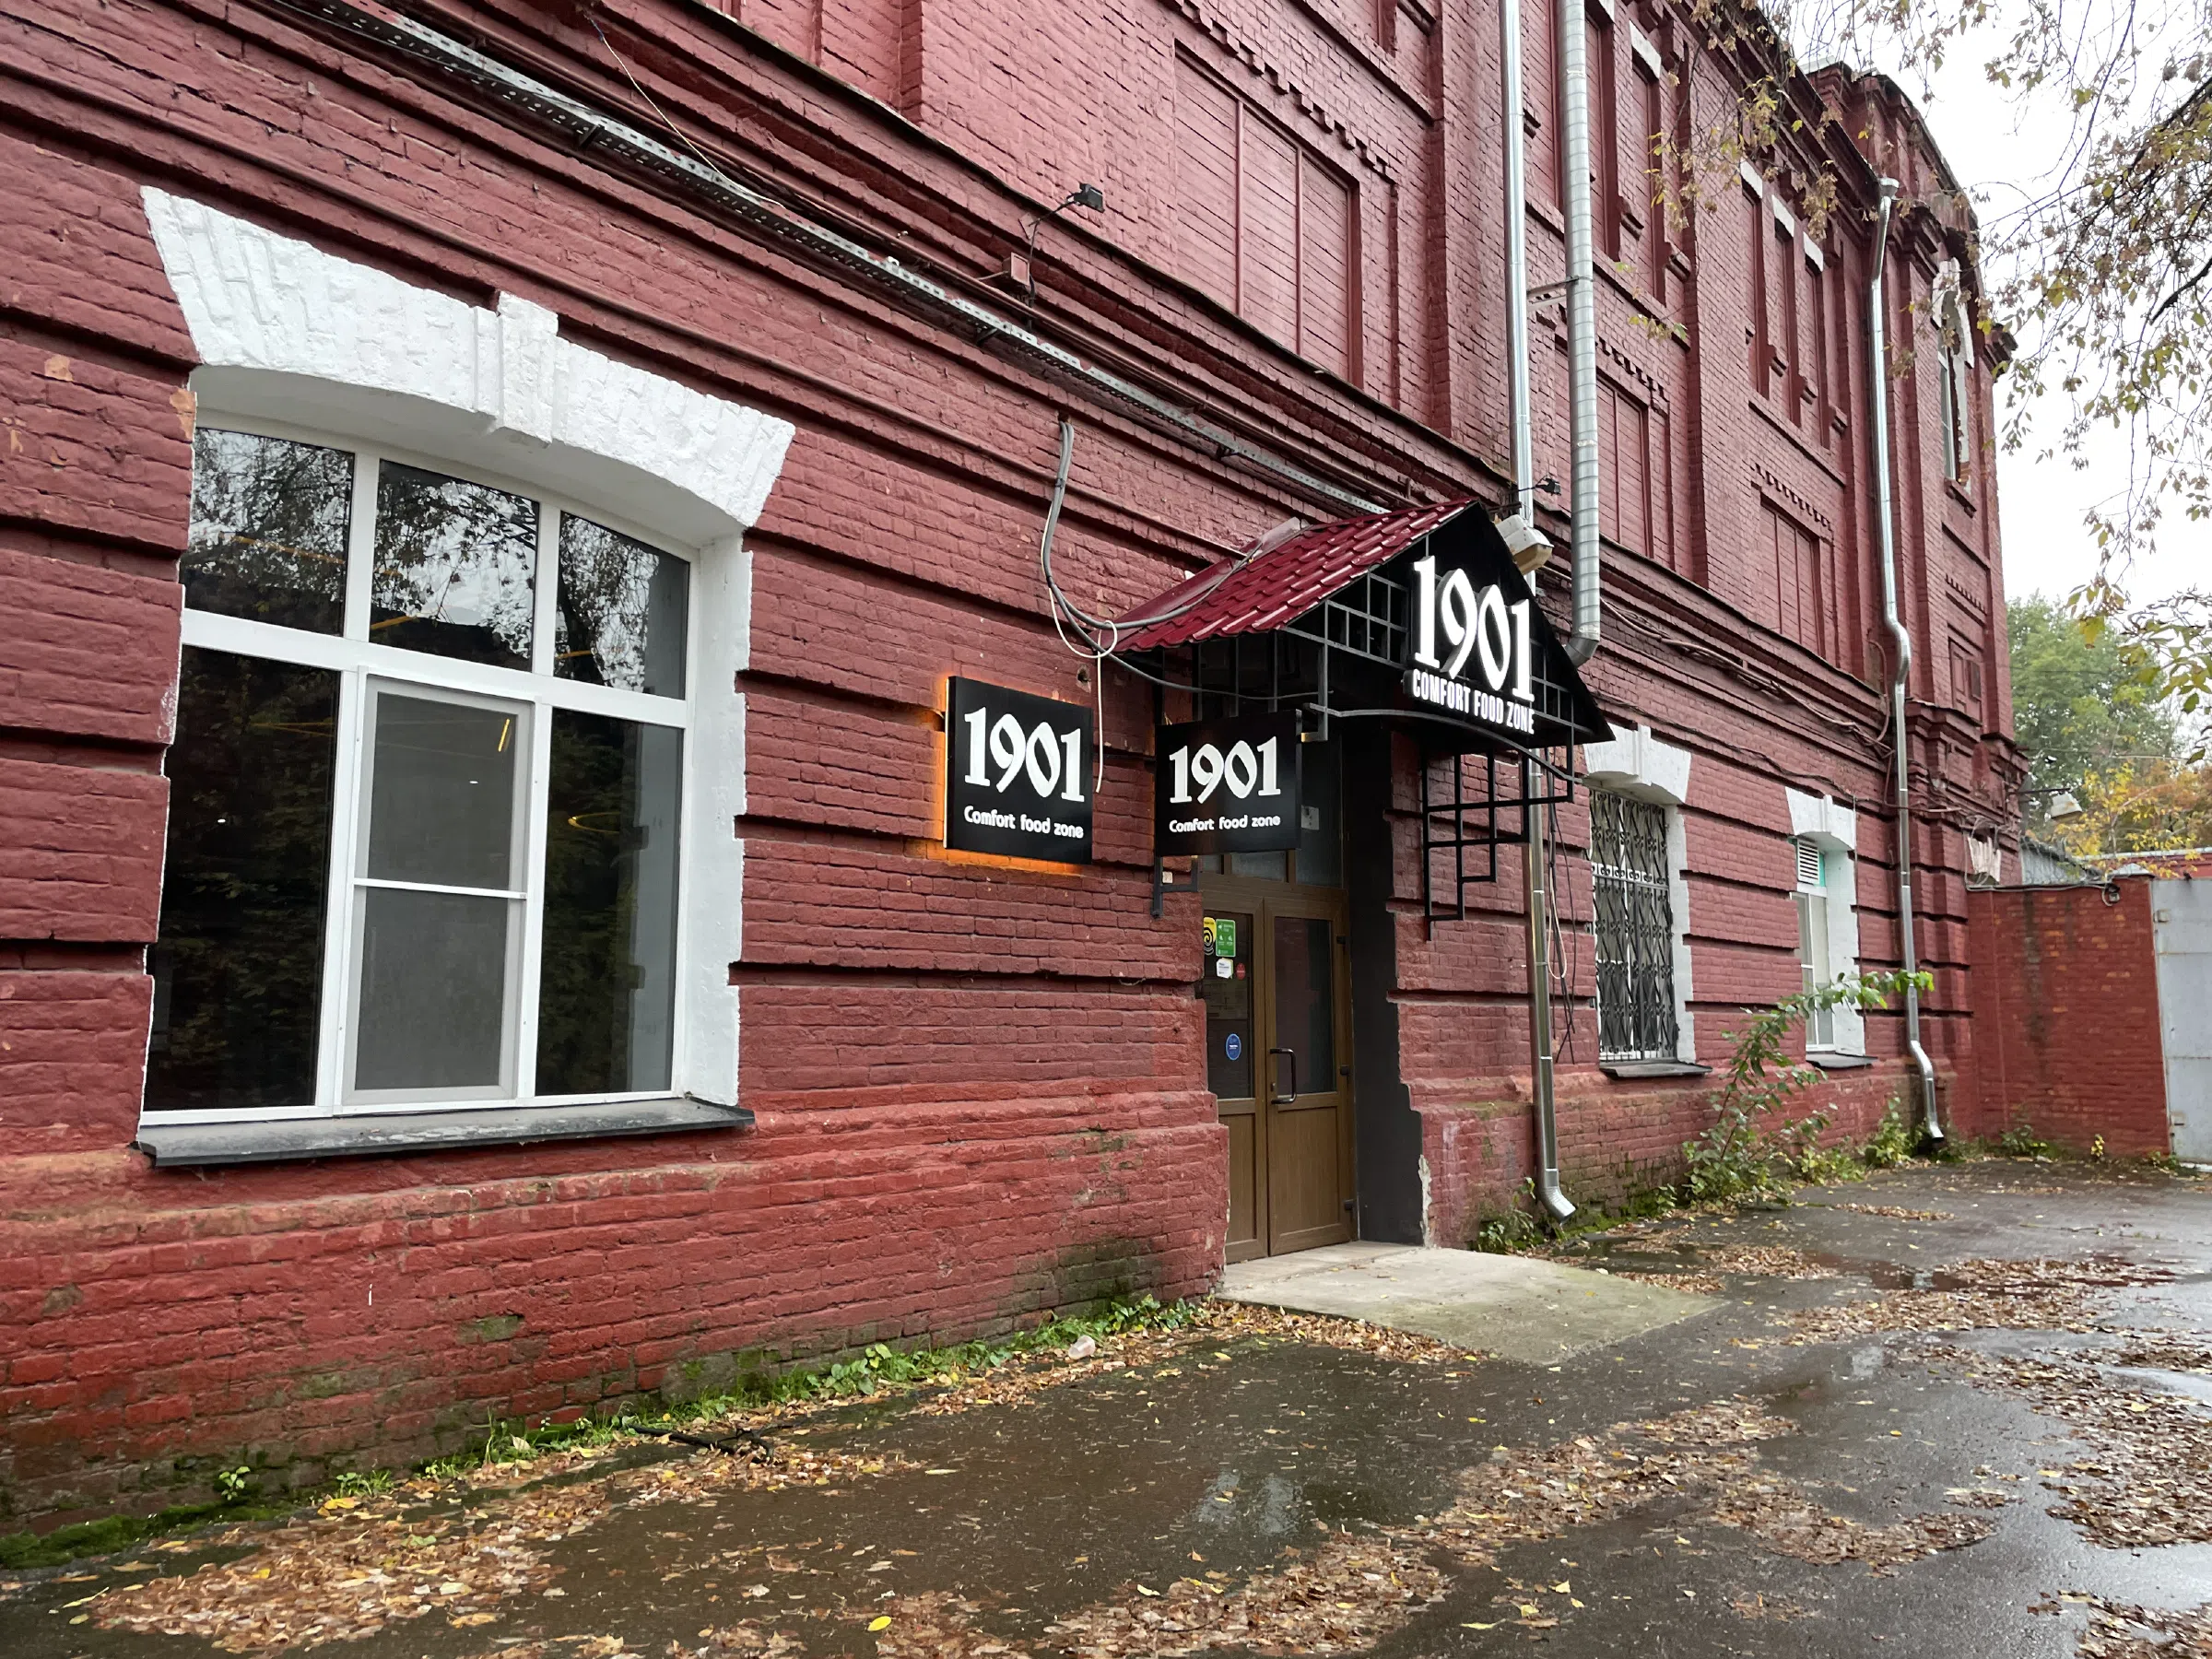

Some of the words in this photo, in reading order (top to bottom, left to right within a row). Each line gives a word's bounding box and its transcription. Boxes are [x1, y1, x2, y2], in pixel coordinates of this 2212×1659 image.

[1413, 555, 1535, 702] 1901
[1412, 668, 1472, 713] COMFORT
[1474, 689, 1504, 724] FOOD
[1506, 700, 1535, 735] ZONE
[964, 706, 1085, 803] 1901
[1169, 735, 1282, 805] 1901
[964, 805, 1017, 830] Comfort
[1019, 813, 1051, 834] food
[1053, 822, 1084, 839] zone
[1169, 819, 1215, 832] Comfort
[1218, 814, 1248, 830] food
[1251, 815, 1281, 828] zone
